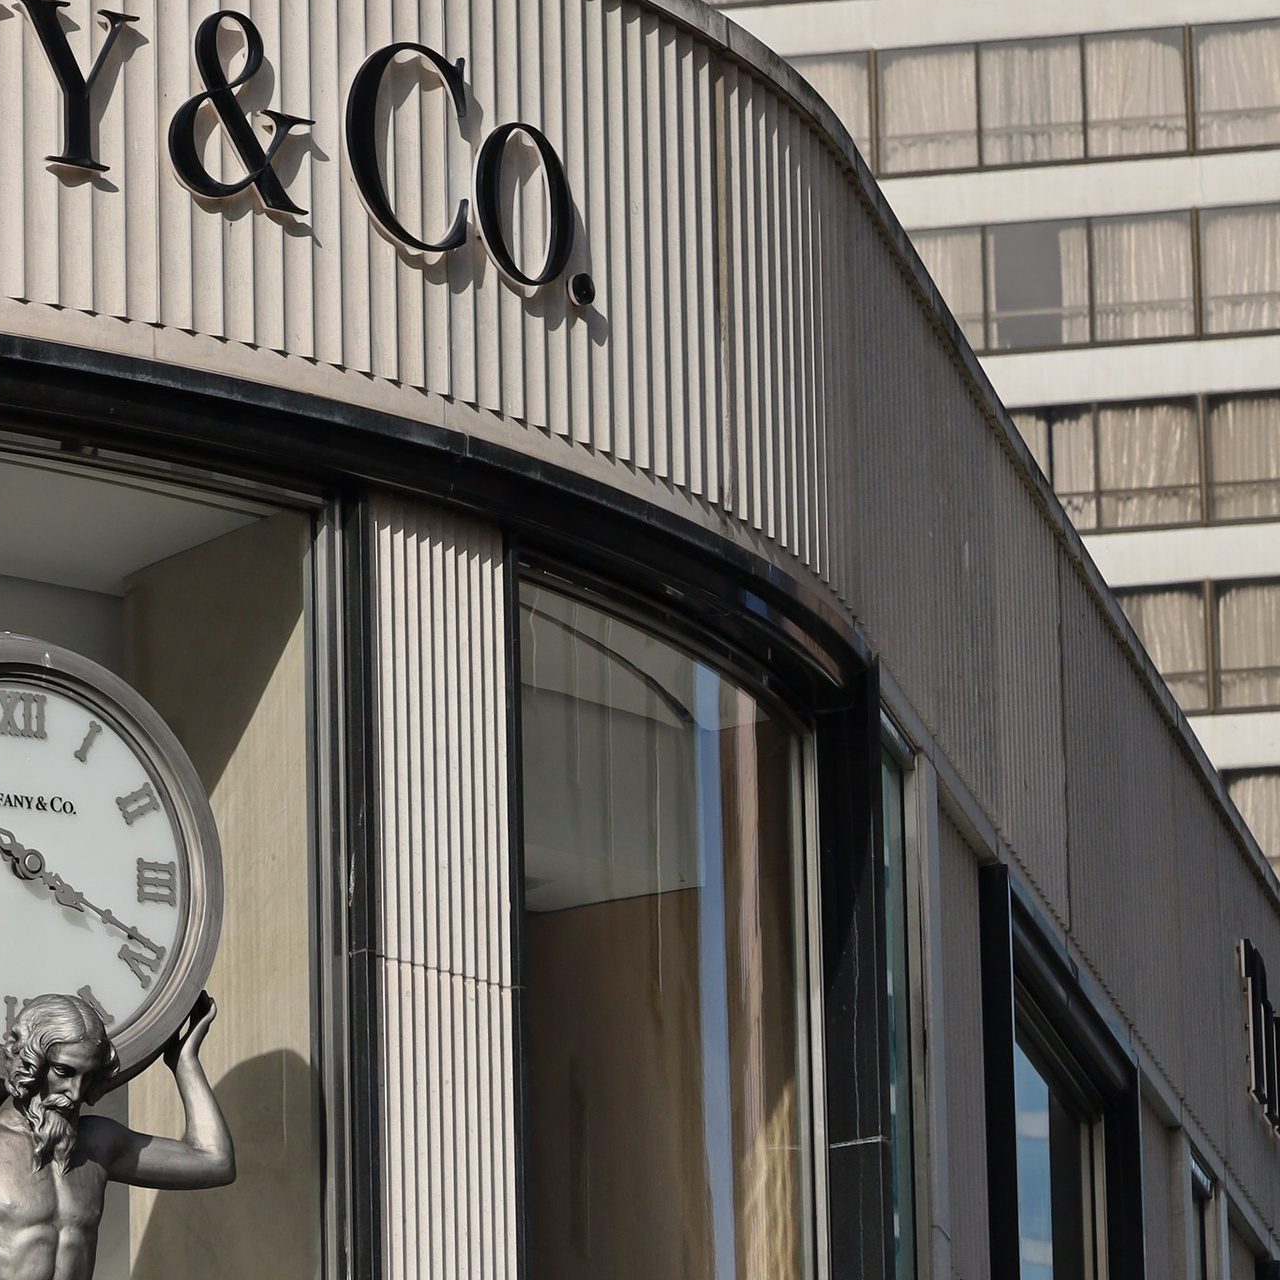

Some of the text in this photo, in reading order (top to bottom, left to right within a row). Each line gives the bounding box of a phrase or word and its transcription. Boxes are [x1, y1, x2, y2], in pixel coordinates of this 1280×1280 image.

[75, 720, 102, 762] I
[116, 782, 160, 824] II
[137, 857, 176, 906] III
